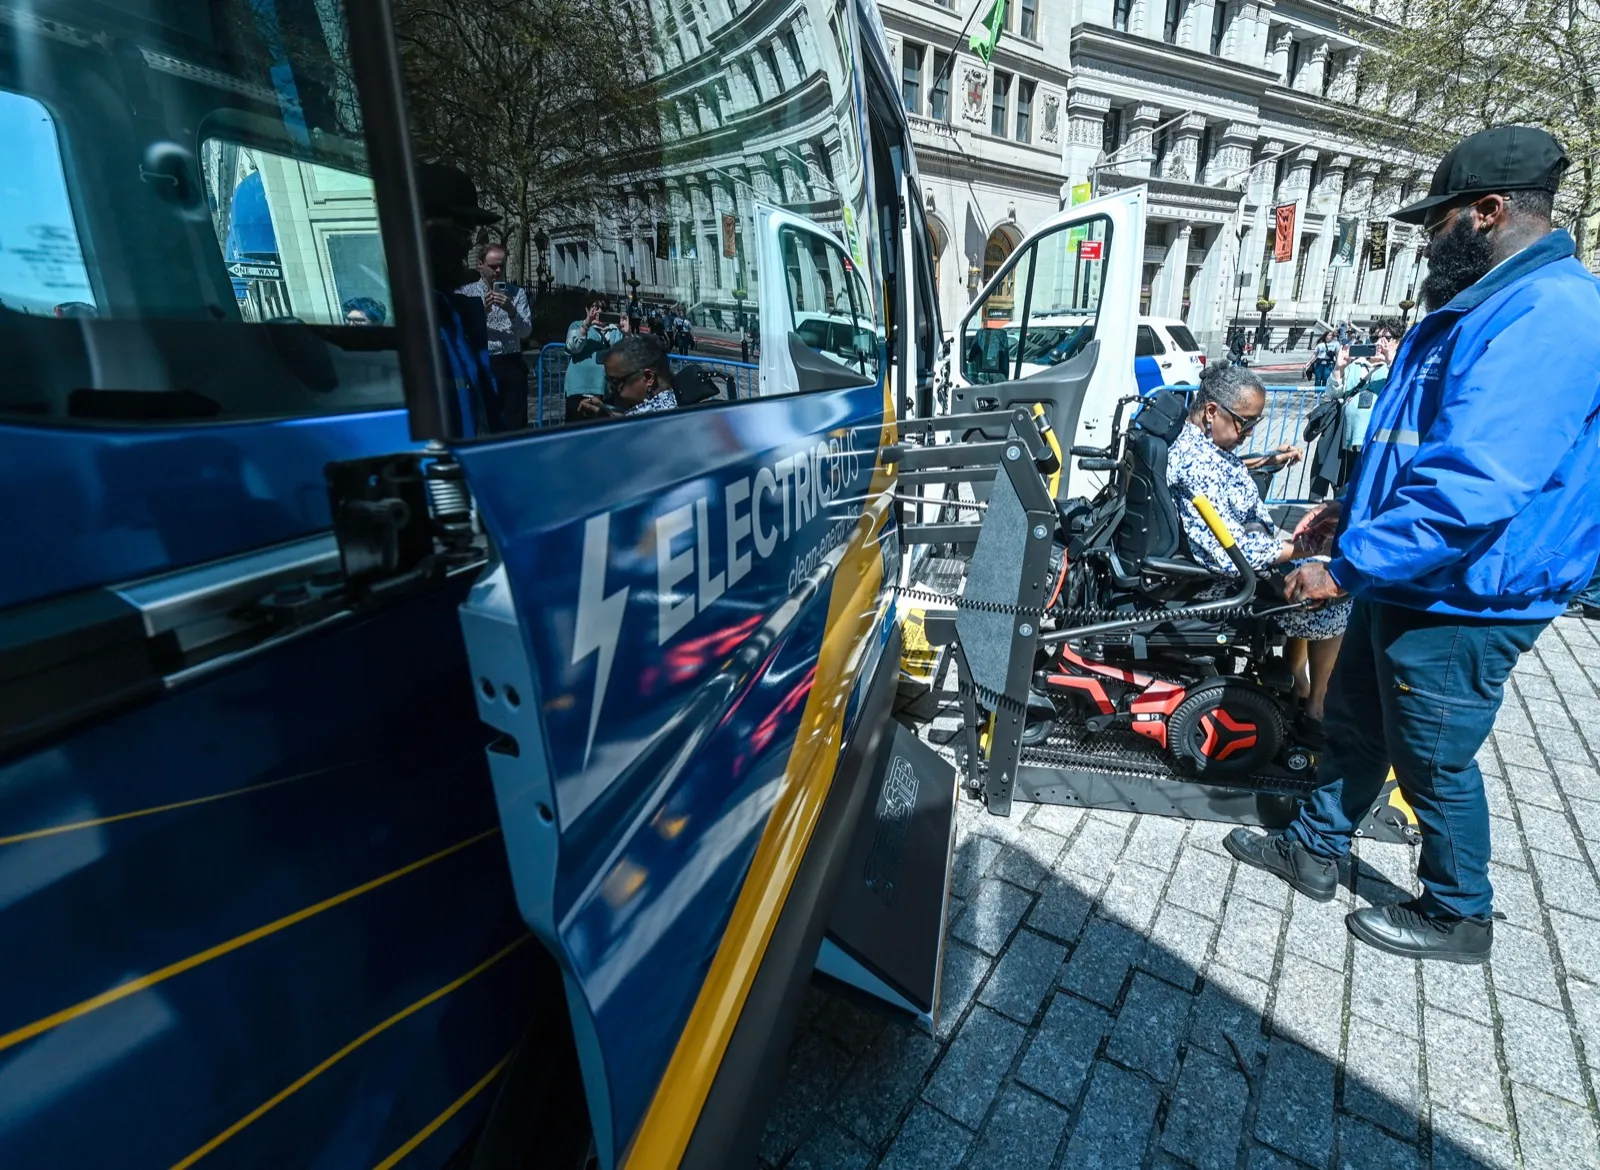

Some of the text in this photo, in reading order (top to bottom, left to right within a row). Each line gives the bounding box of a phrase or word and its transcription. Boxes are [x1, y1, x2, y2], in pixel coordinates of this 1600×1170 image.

[1281, 215, 1290, 251] WINE
[233, 266, 276, 276] ONE WAY
[656, 431, 859, 647] ELECTRICBUS
[788, 519, 847, 595] clean-energy
